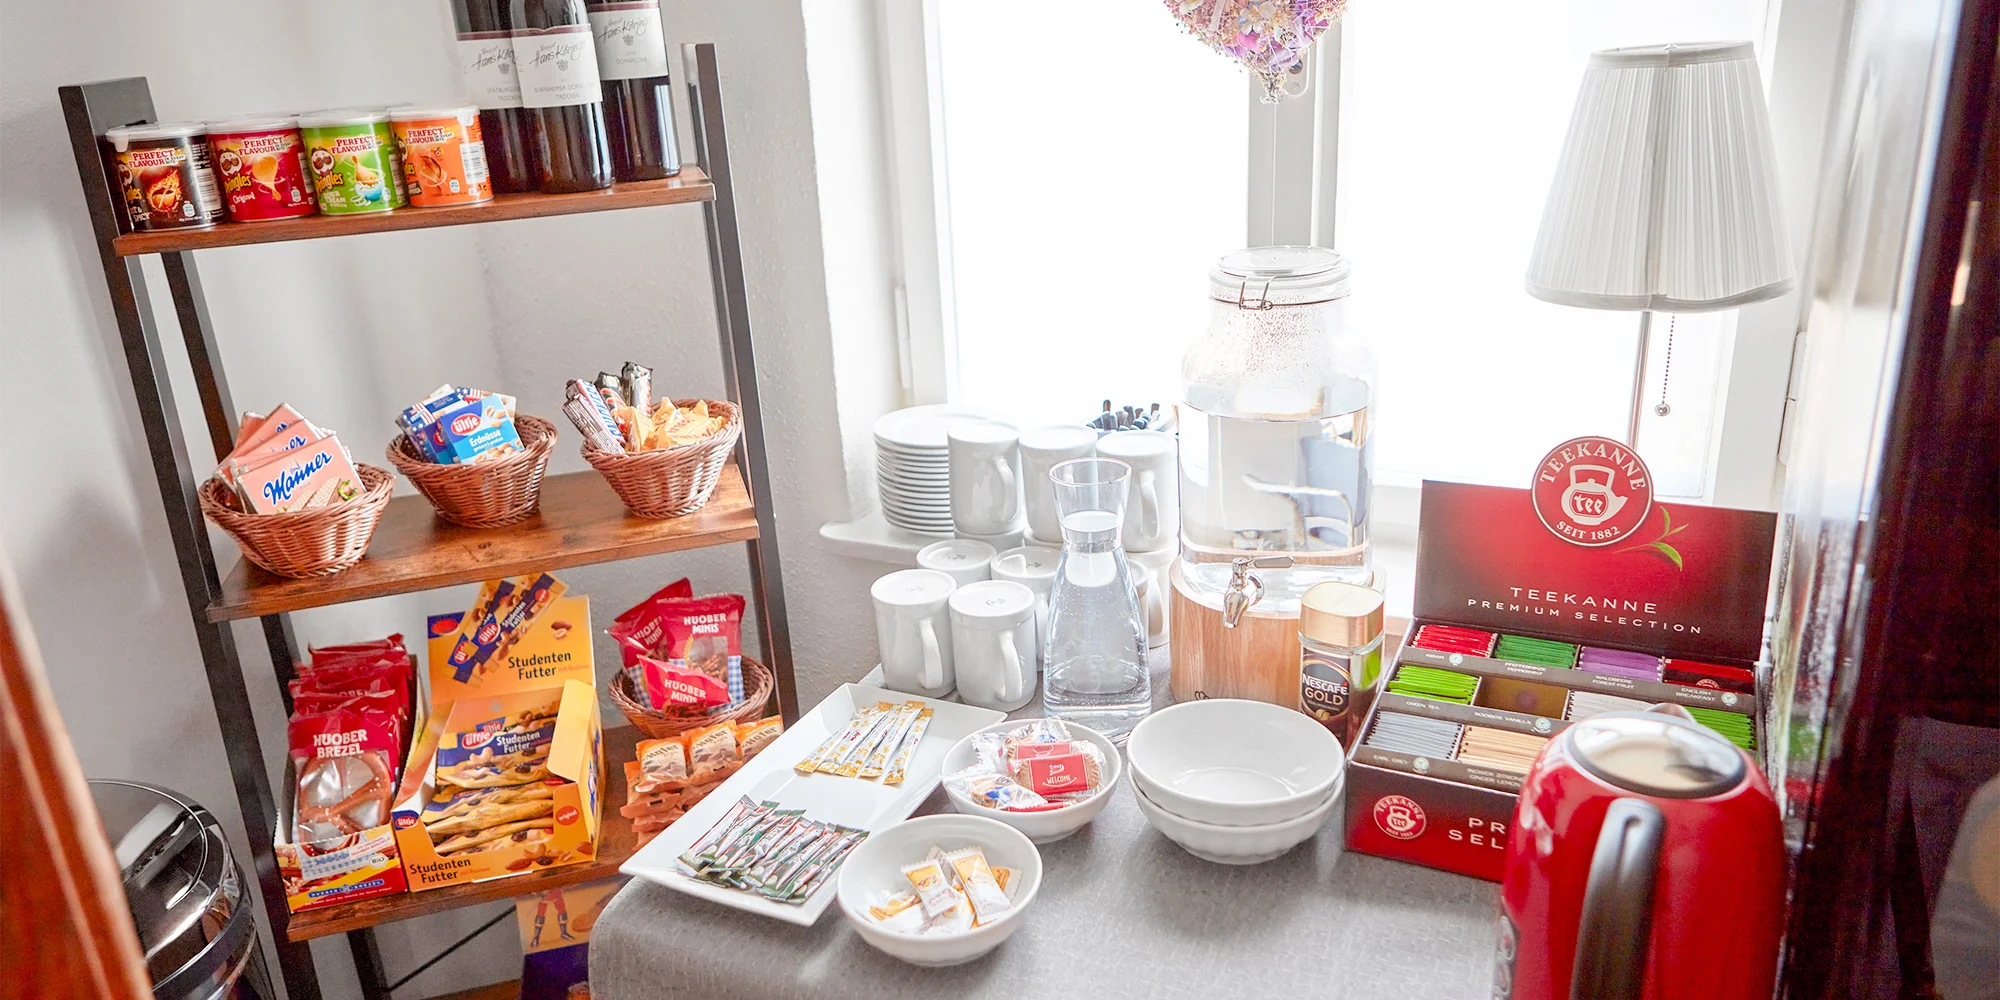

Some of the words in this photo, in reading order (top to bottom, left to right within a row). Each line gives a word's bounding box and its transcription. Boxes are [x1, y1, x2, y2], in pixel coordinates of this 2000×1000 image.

[406, 127, 444, 137] PERFECT
[243, 137, 284, 149] PERFECT
[404, 136, 434, 144] FLAVOUR
[132, 150, 174, 160] PERFECT
[238, 146, 275, 156] FLAVOUR
[331, 145, 368, 154] FLAVOUR
[129, 160, 165, 168] FLAVOUR
[468, 429, 501, 447] Erdnüsse
[1539, 442, 1646, 491] TEEKANNE
[264, 452, 332, 505] Manner
[1573, 493, 1604, 515] tee
[1556, 520, 1587, 540] SEIT
[1590, 526, 1619, 540] 1882
[1509, 586, 1658, 614] TEEKANNE
[683, 613, 727, 625] HUOBER
[1467, 598, 1560, 617] PREMIUM
[1574, 611, 1702, 634] SELECTION
[692, 623, 720, 634] MINIS
[508, 652, 572, 669] Studenten
[518, 666, 557, 680] Futter
[664, 679, 707, 698] HUOBER
[1681, 687, 1712, 696] ENGLISH
[1305, 687, 1344, 705] GOLD
[1675, 692, 1716, 702] BREAKFAST
[1406, 701, 1426, 709] GREEN
[1504, 716, 1532, 725] VANILLA
[313, 729, 368, 747] HUOBER
[496, 731, 540, 746] Studenten
[316, 743, 364, 759] BREZEL
[504, 742, 531, 753] Futter
[1046, 774, 1071, 784] WELCOME
[409, 858, 471, 875] Studenten
[421, 870, 458, 883] Futter
